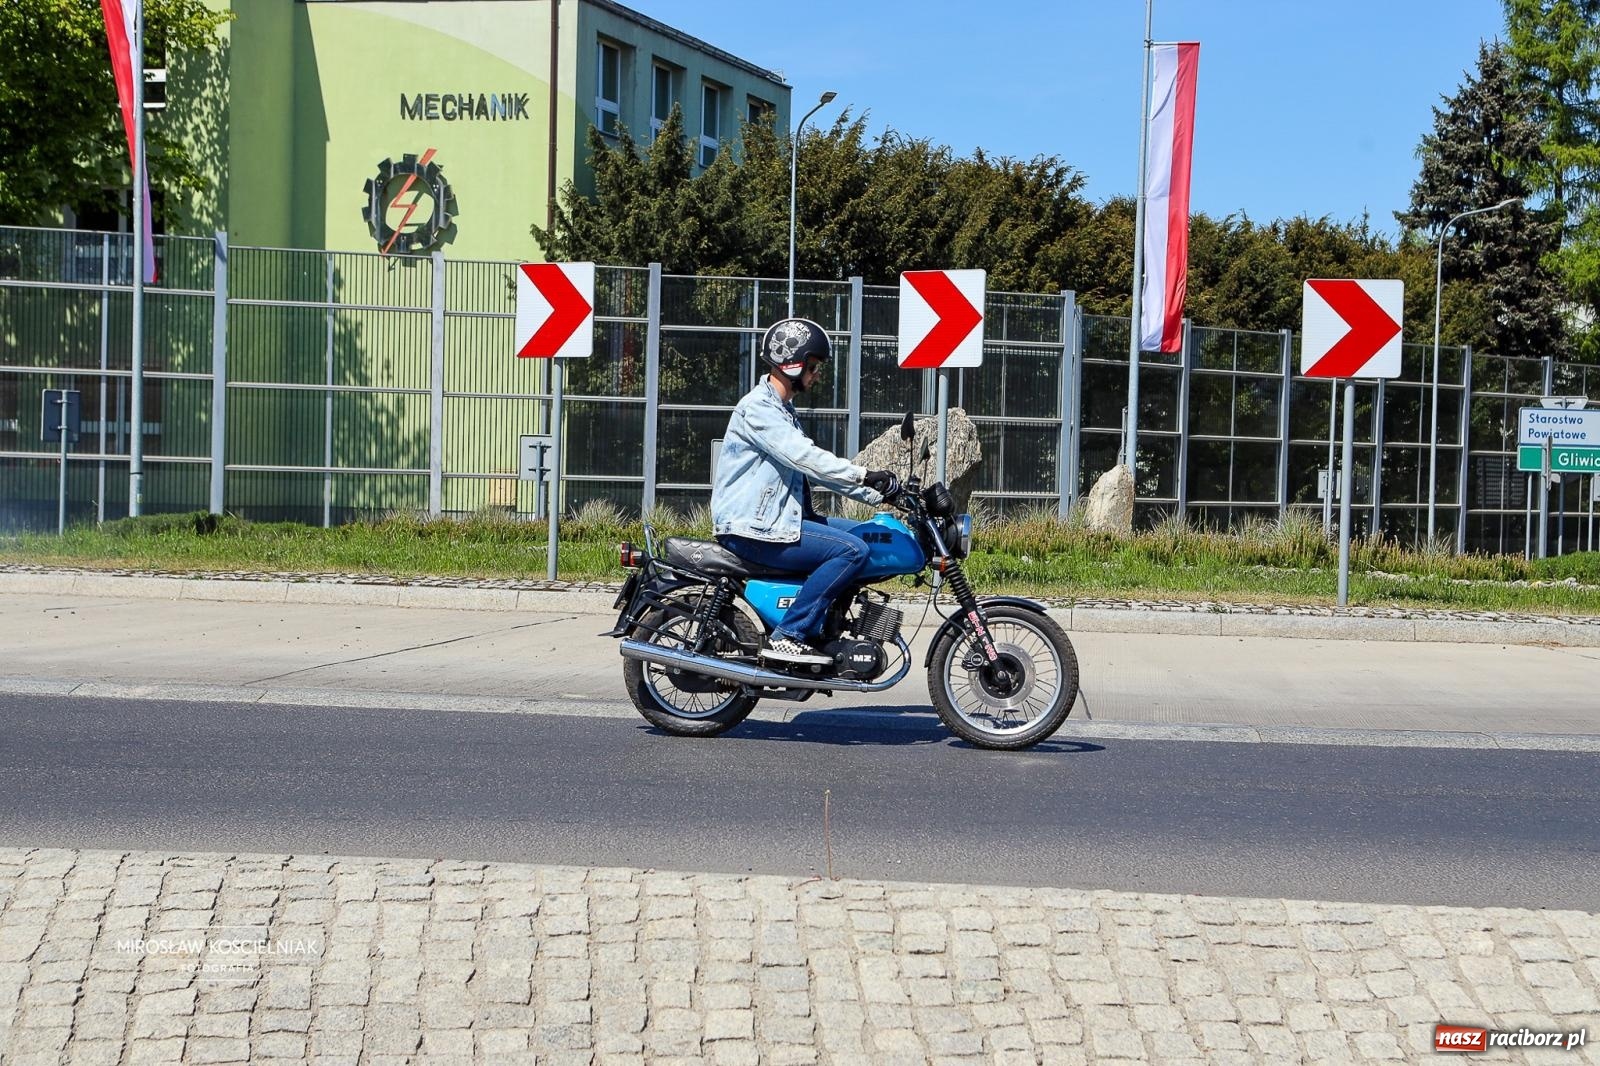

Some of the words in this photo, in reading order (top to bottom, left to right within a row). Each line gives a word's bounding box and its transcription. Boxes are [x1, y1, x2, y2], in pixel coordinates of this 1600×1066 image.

[400, 93, 530, 121] MECHANIK
[1528, 413, 1583, 424] Starostwo
[1528, 428, 1587, 439] Powiatowe
[862, 532, 892, 544] MZ
[853, 654, 872, 662] MZ
